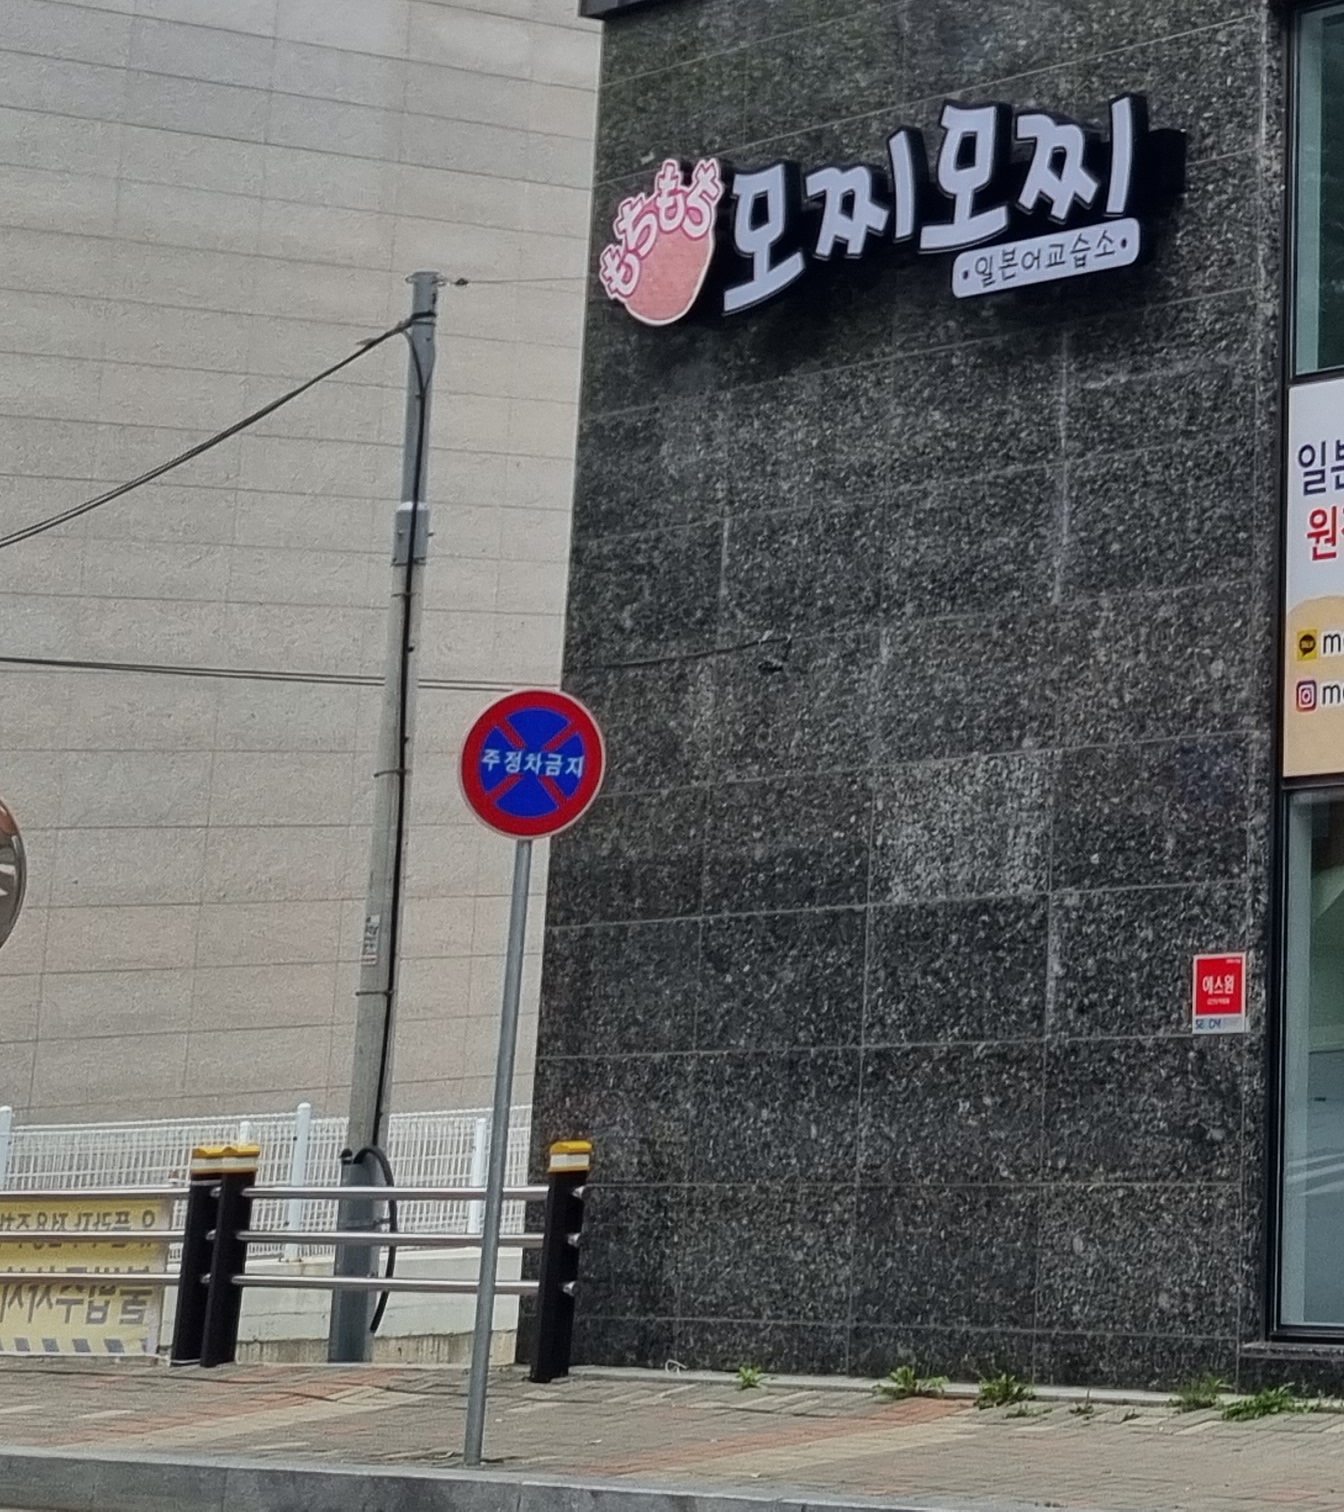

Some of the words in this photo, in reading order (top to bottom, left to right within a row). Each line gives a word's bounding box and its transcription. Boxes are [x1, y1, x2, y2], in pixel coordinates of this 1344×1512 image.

[722, 96, 1133, 317] 모찌모찌
[973, 232, 1117, 289] 일본어교습소
[480, 746, 585, 779] 주정차금지
[1202, 974, 1235, 995] 에스원
